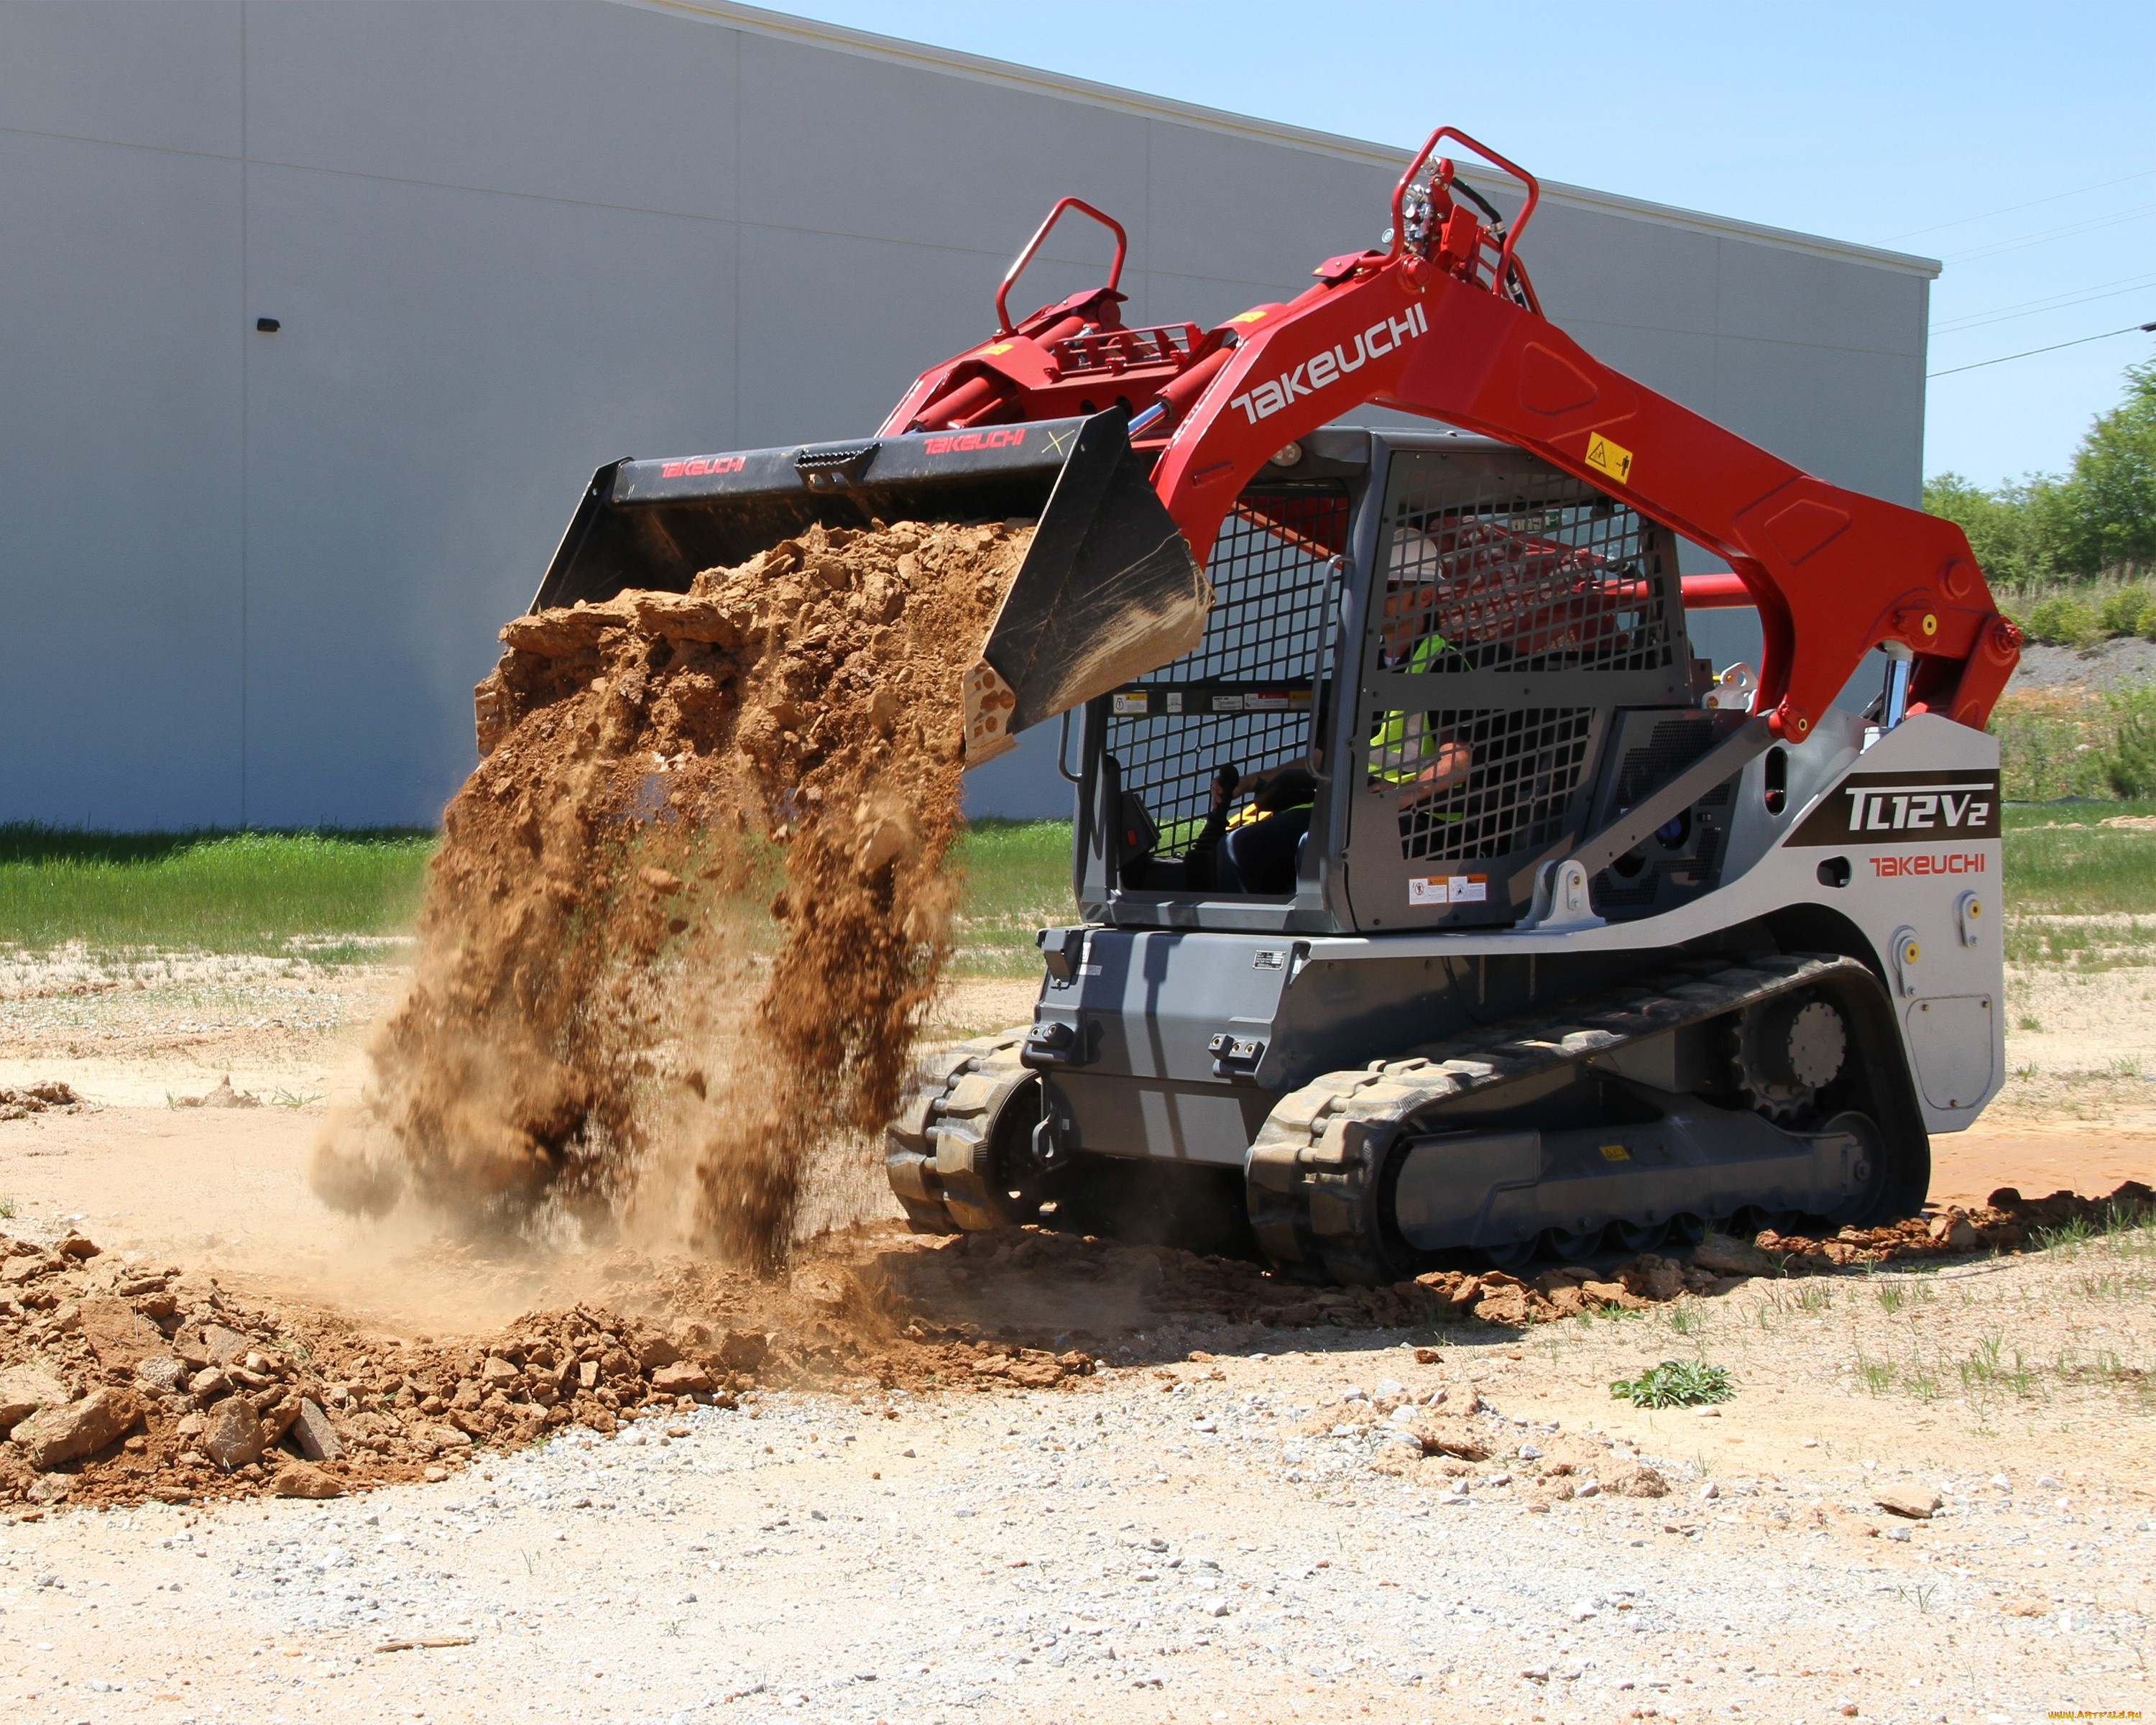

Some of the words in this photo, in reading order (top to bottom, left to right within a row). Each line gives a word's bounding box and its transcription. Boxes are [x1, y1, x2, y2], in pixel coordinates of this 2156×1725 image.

[1231, 303, 1428, 424] TAKEUCHI
[923, 428, 1026, 454] TAKEUCHI
[661, 456, 746, 478] TAKEUCHI
[1846, 783, 1994, 831] TL12V2
[1869, 853, 1985, 877] TAKEUCHI
